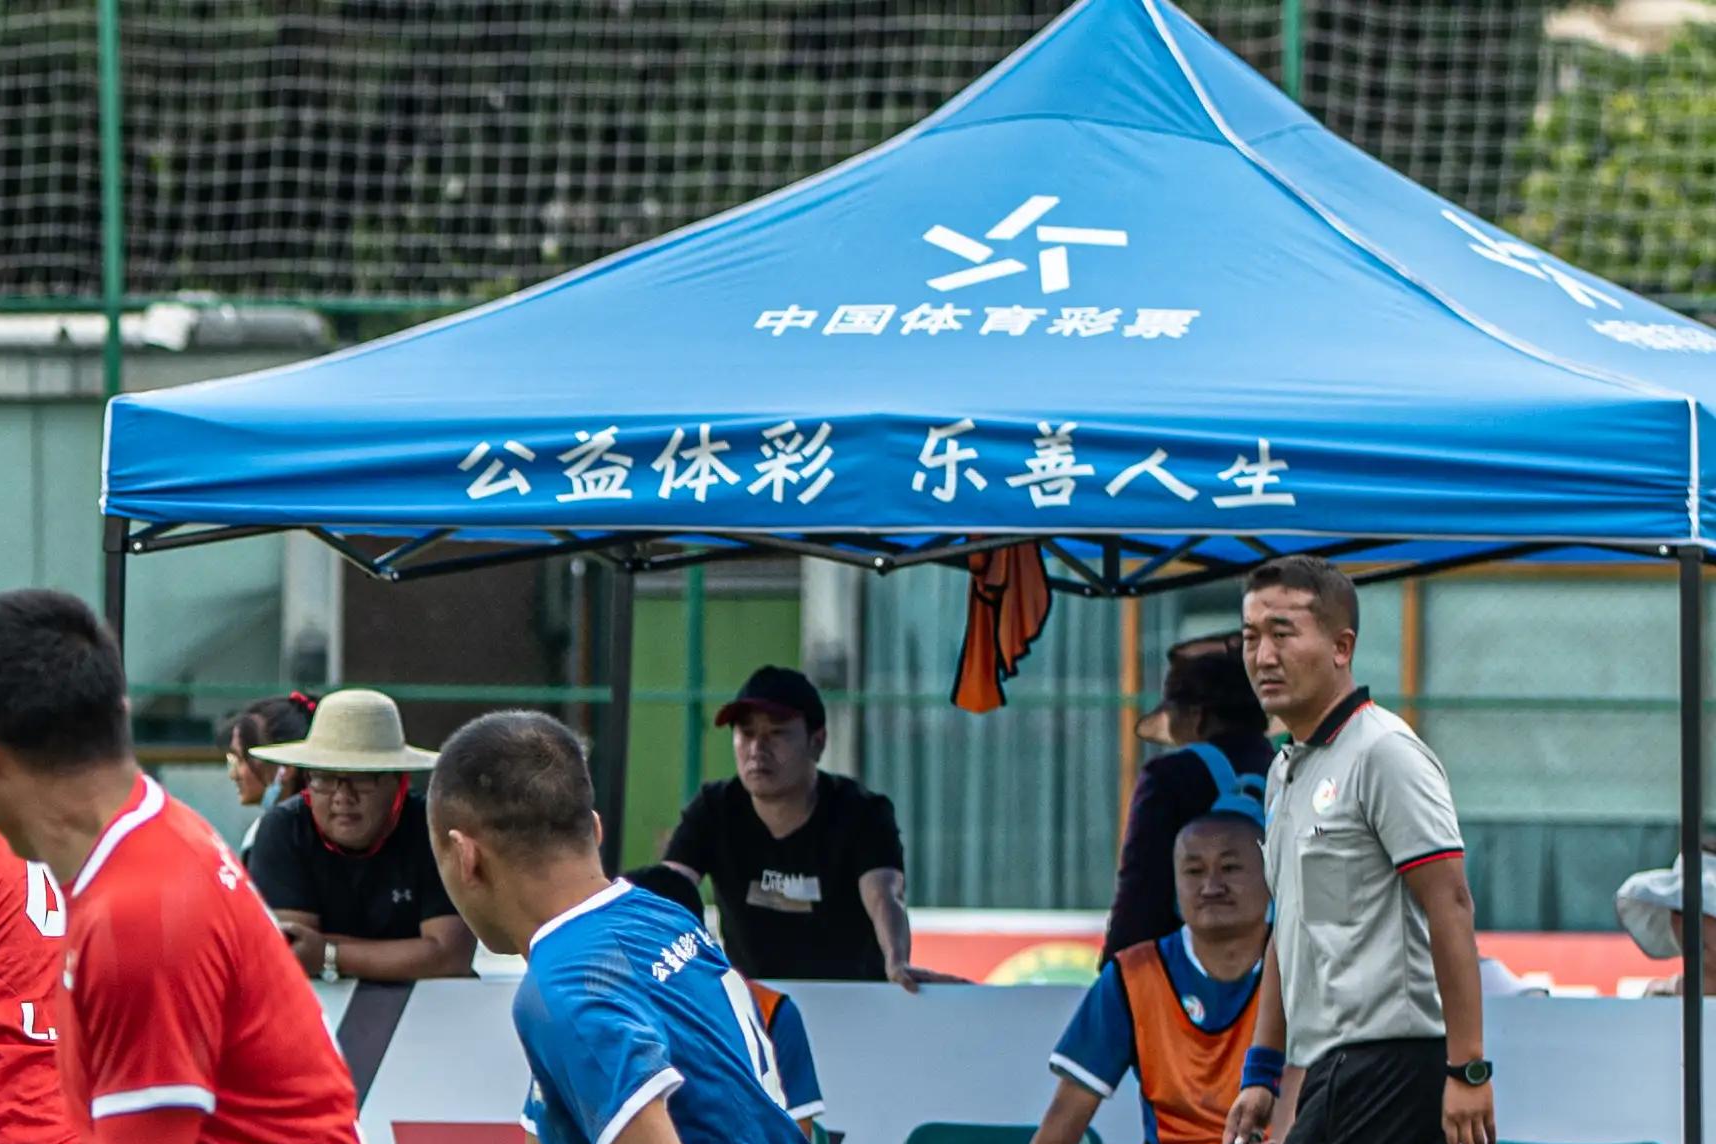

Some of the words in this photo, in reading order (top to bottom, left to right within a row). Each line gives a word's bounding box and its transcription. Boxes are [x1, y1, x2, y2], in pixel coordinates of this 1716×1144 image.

[754, 304, 1201, 338] 中国体育彩票
[457, 420, 834, 504] 公益体彩
[910, 416, 1296, 510] 乐善人生
